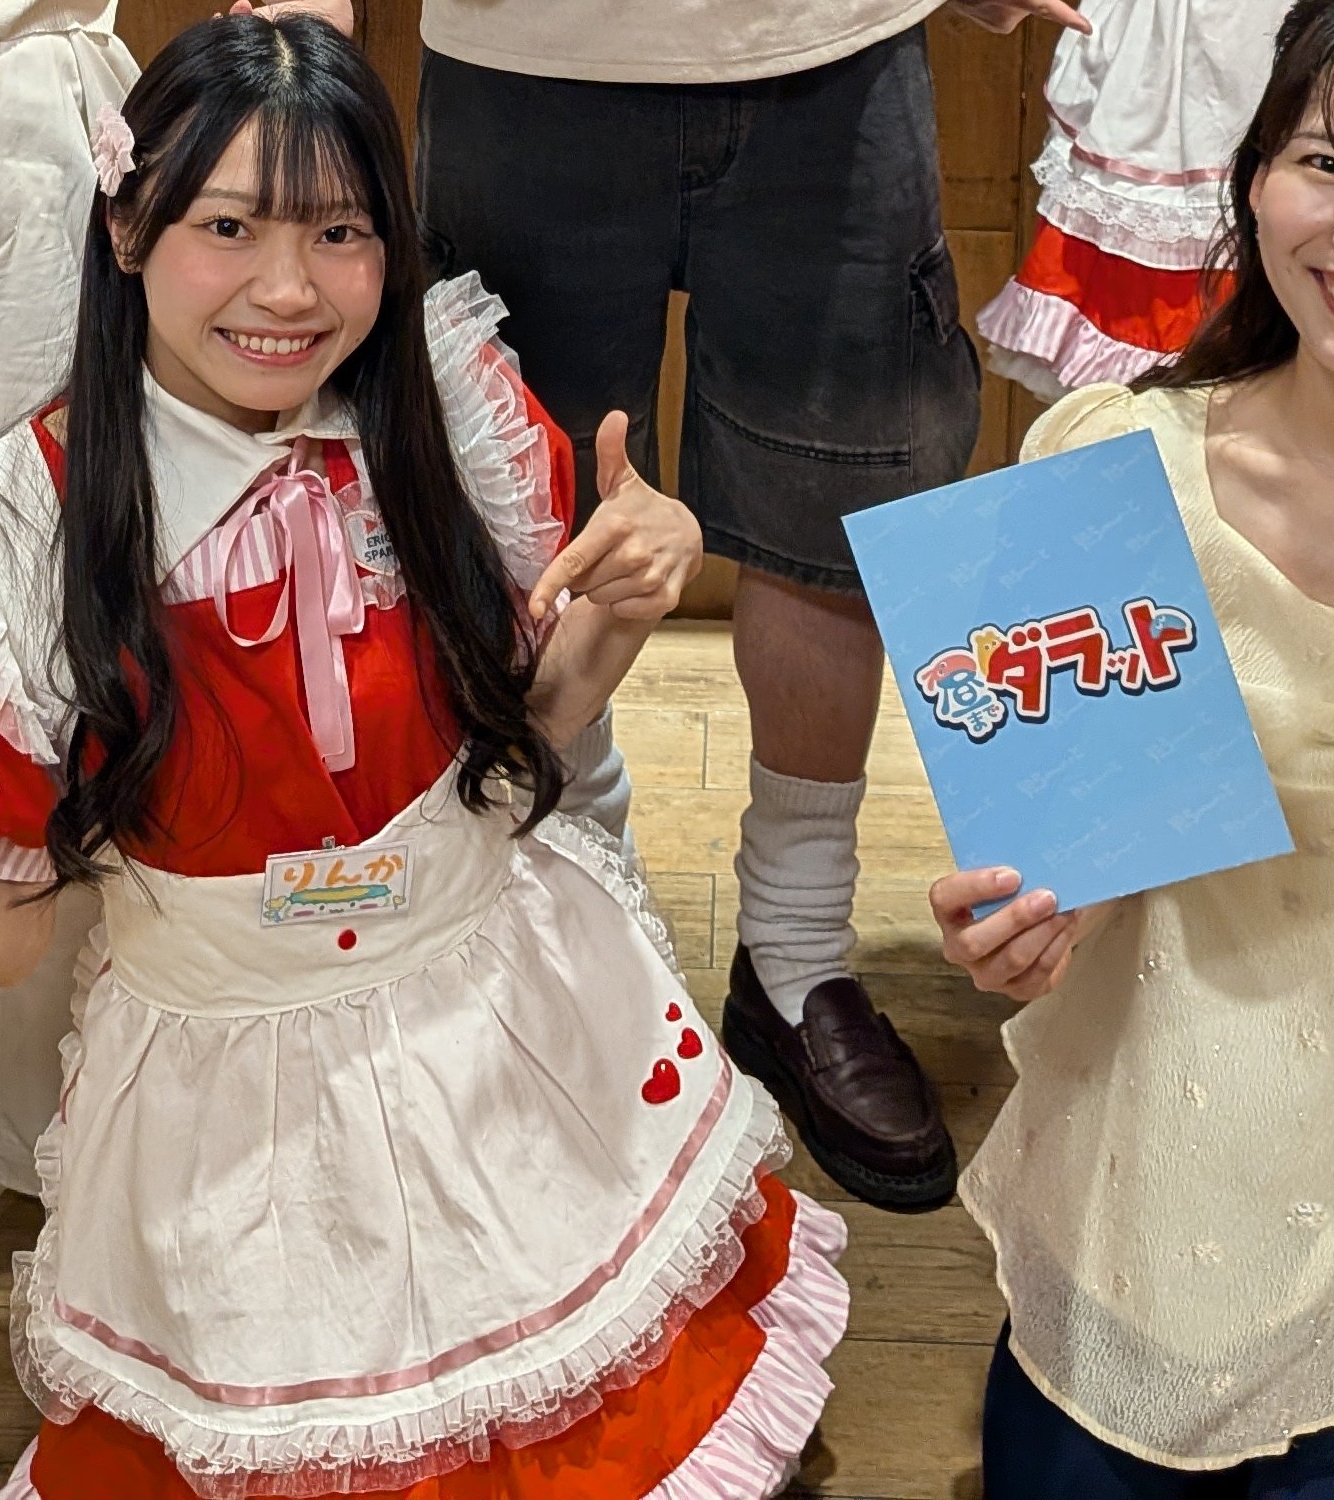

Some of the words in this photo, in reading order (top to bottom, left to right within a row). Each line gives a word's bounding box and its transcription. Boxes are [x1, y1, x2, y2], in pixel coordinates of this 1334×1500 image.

[366, 533, 391, 548] ERIC
[283, 854, 404, 892] りんか
